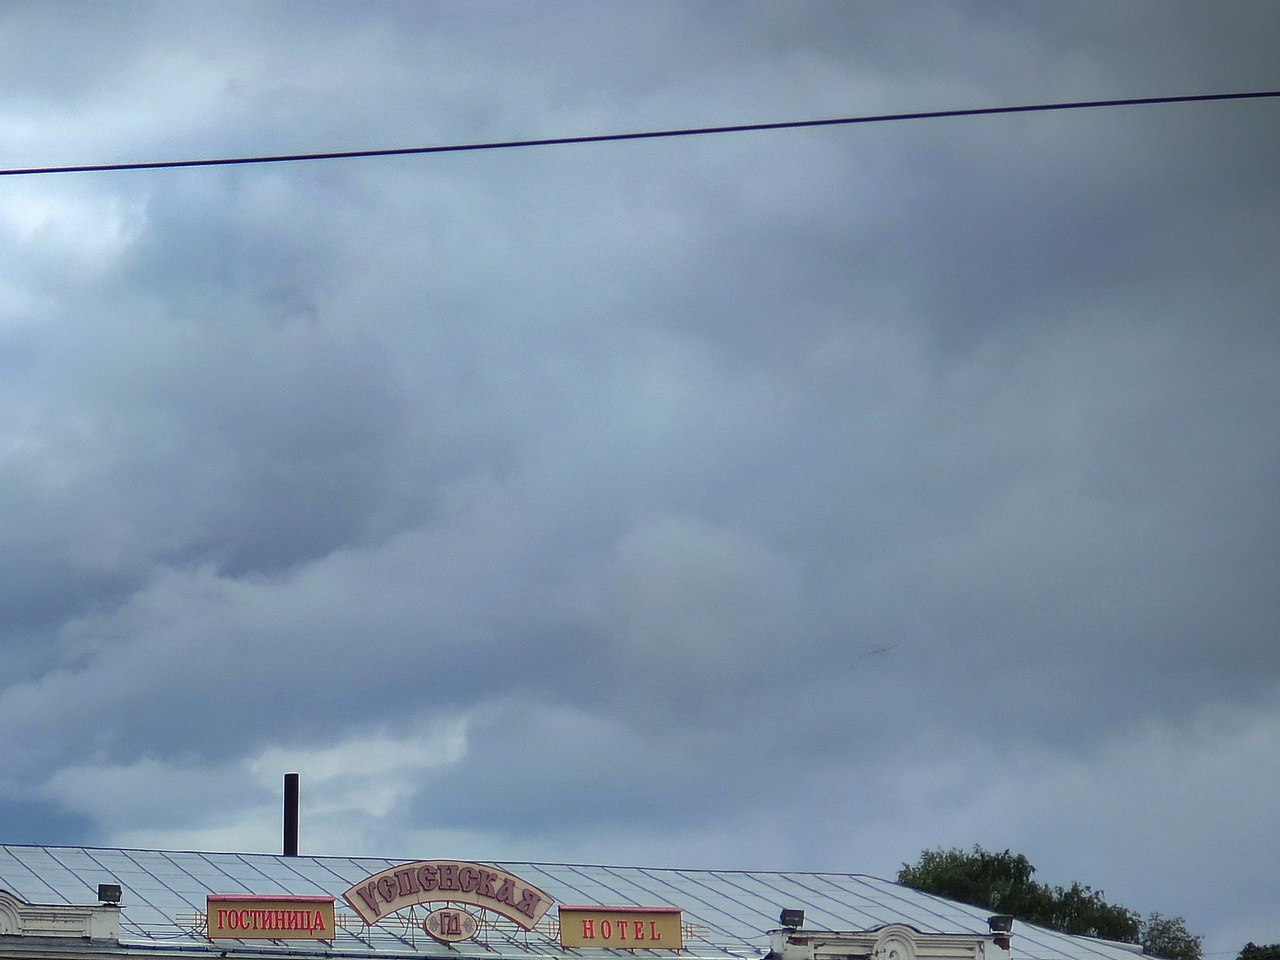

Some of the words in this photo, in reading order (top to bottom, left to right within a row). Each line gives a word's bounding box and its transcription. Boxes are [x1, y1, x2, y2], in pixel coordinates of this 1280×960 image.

[356, 864, 542, 919] УСПЕНСКАЯ
[217, 909, 326, 936] ГОСТИНИЦА
[440, 912, 462, 935] ГД
[581, 919, 661, 941] HOTEL
